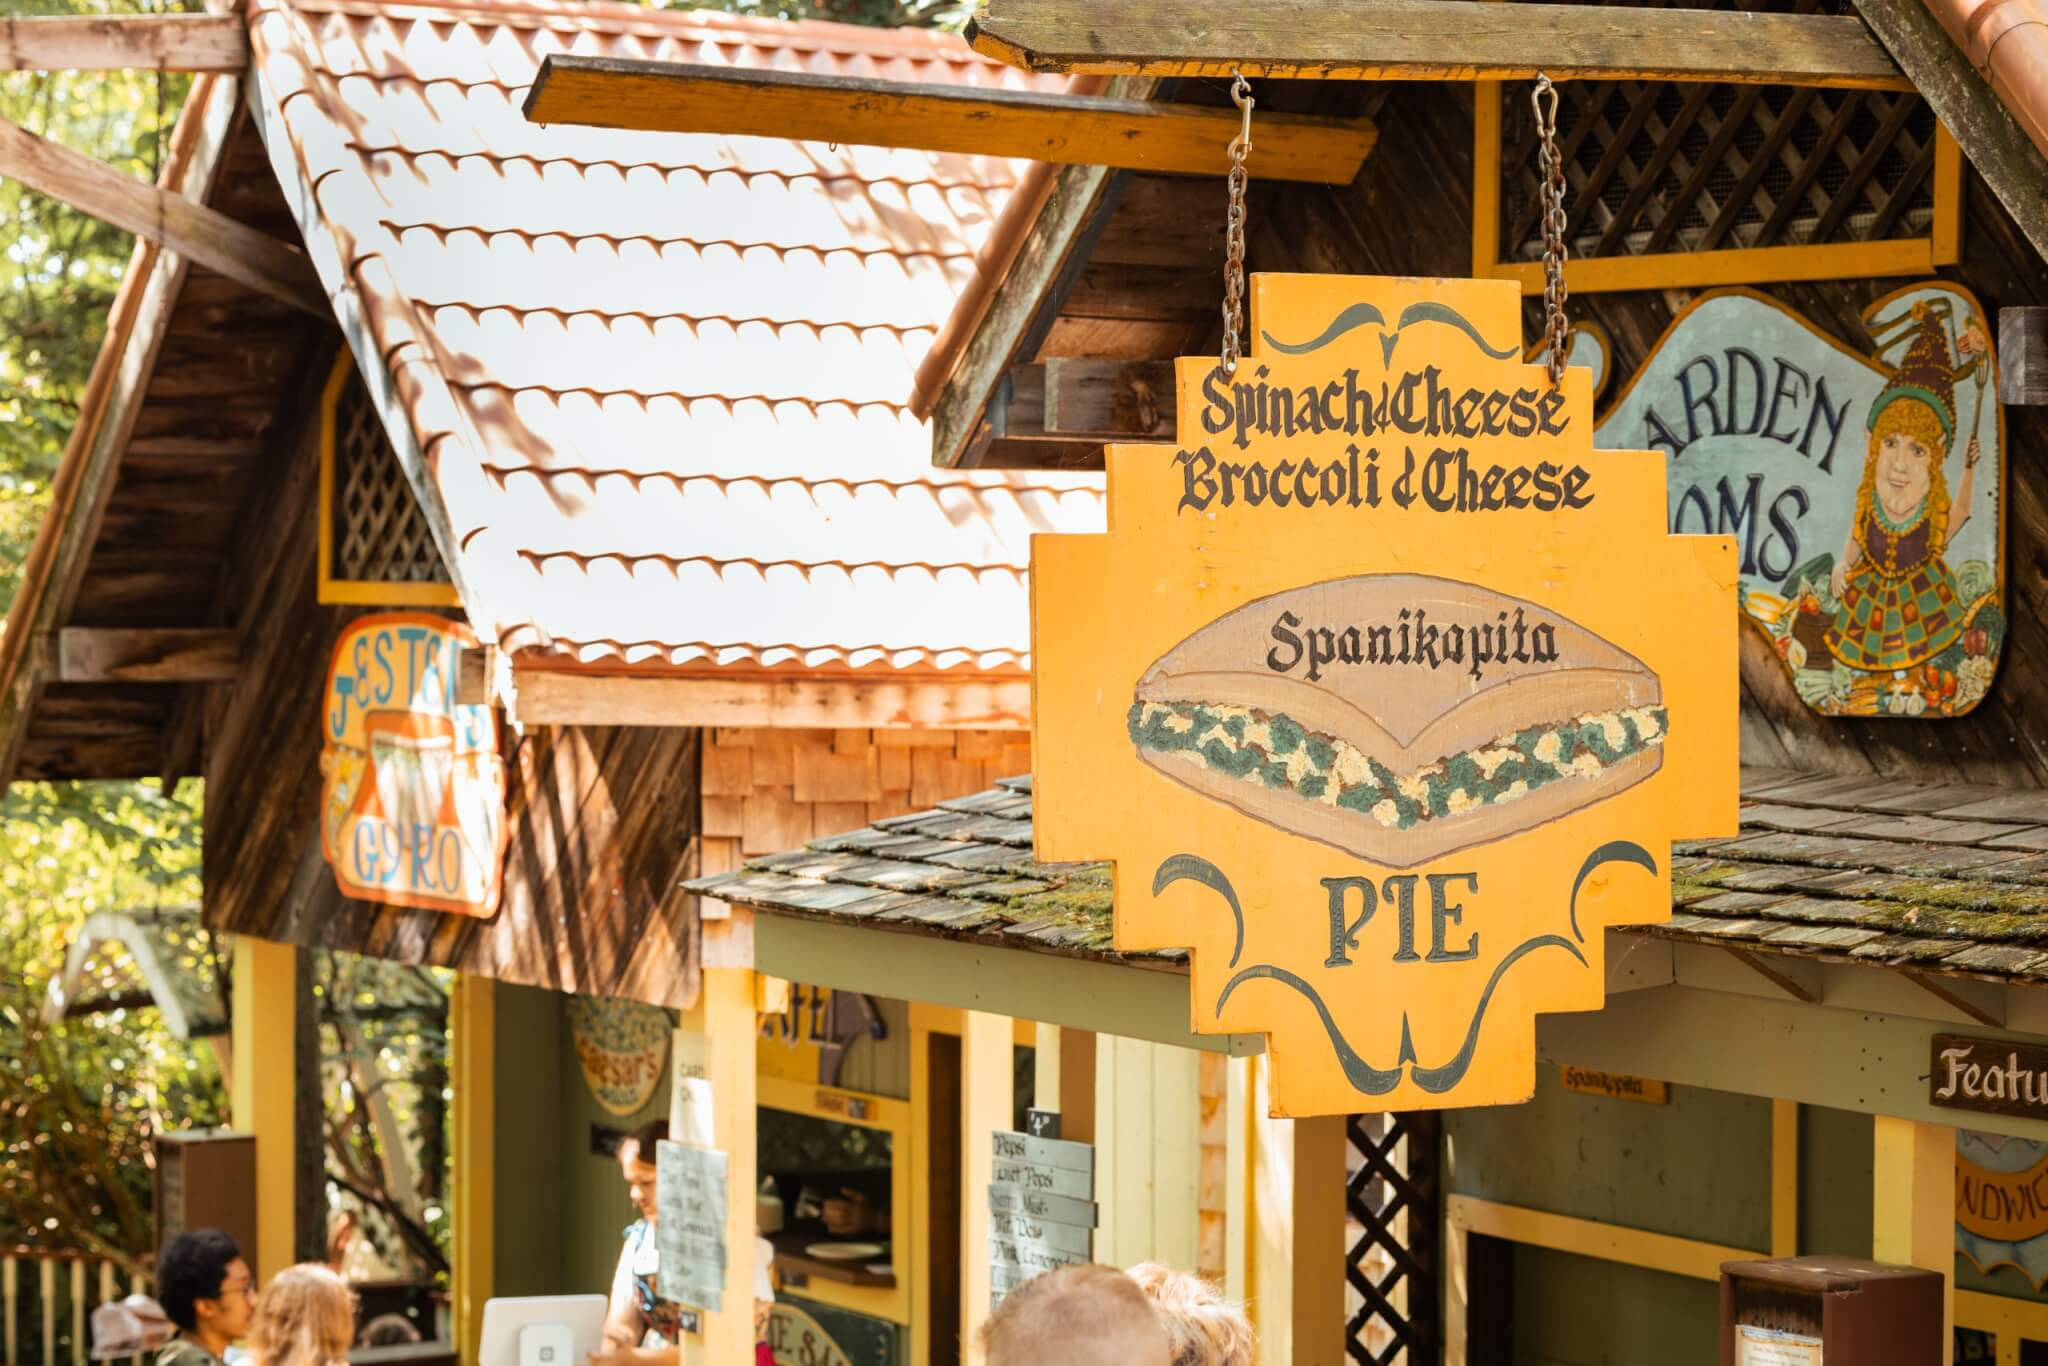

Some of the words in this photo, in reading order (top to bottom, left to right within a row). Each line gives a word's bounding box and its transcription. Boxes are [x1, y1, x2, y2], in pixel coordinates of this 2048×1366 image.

[1200, 364, 1375, 449] Spinach
[1390, 364, 1571, 439] Cheese
[1171, 443, 1381, 516] Broccoli
[1421, 447, 1595, 513] Cheese
[353, 820, 463, 894] GYRO
[1319, 871, 1479, 968] PIE
[993, 1135, 1025, 1158] Pepsi
[1024, 1166, 1054, 1189] Pepsi
